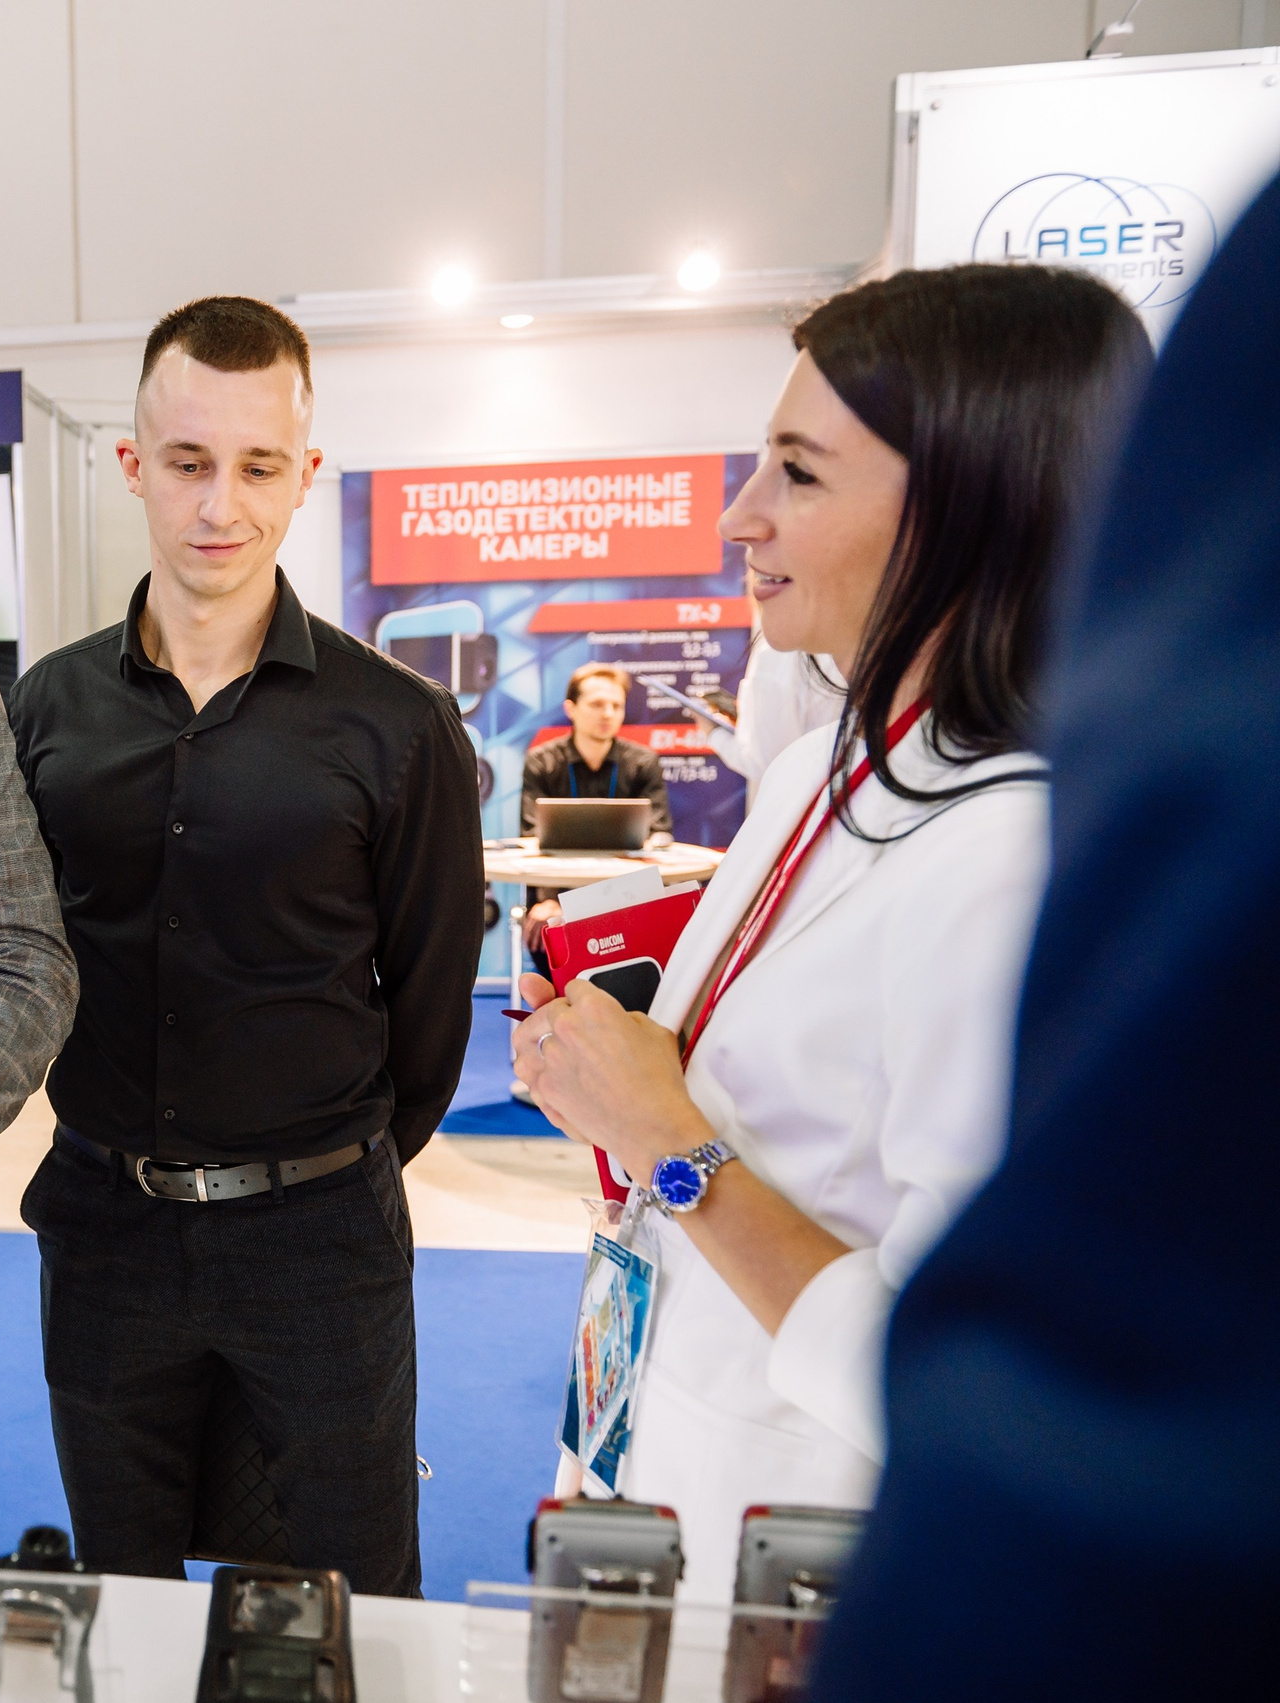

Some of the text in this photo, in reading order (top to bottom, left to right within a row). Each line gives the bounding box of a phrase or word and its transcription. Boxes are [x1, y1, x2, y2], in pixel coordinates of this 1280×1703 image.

[1004, 221, 1184, 260] LASER
[402, 472, 691, 509] ТЕПЛОВИЗИОННЫЕ
[402, 500, 691, 537] ГАЗОДЕТЕКТОРНЫЕ
[480, 533, 609, 561] КАМЕРЫ
